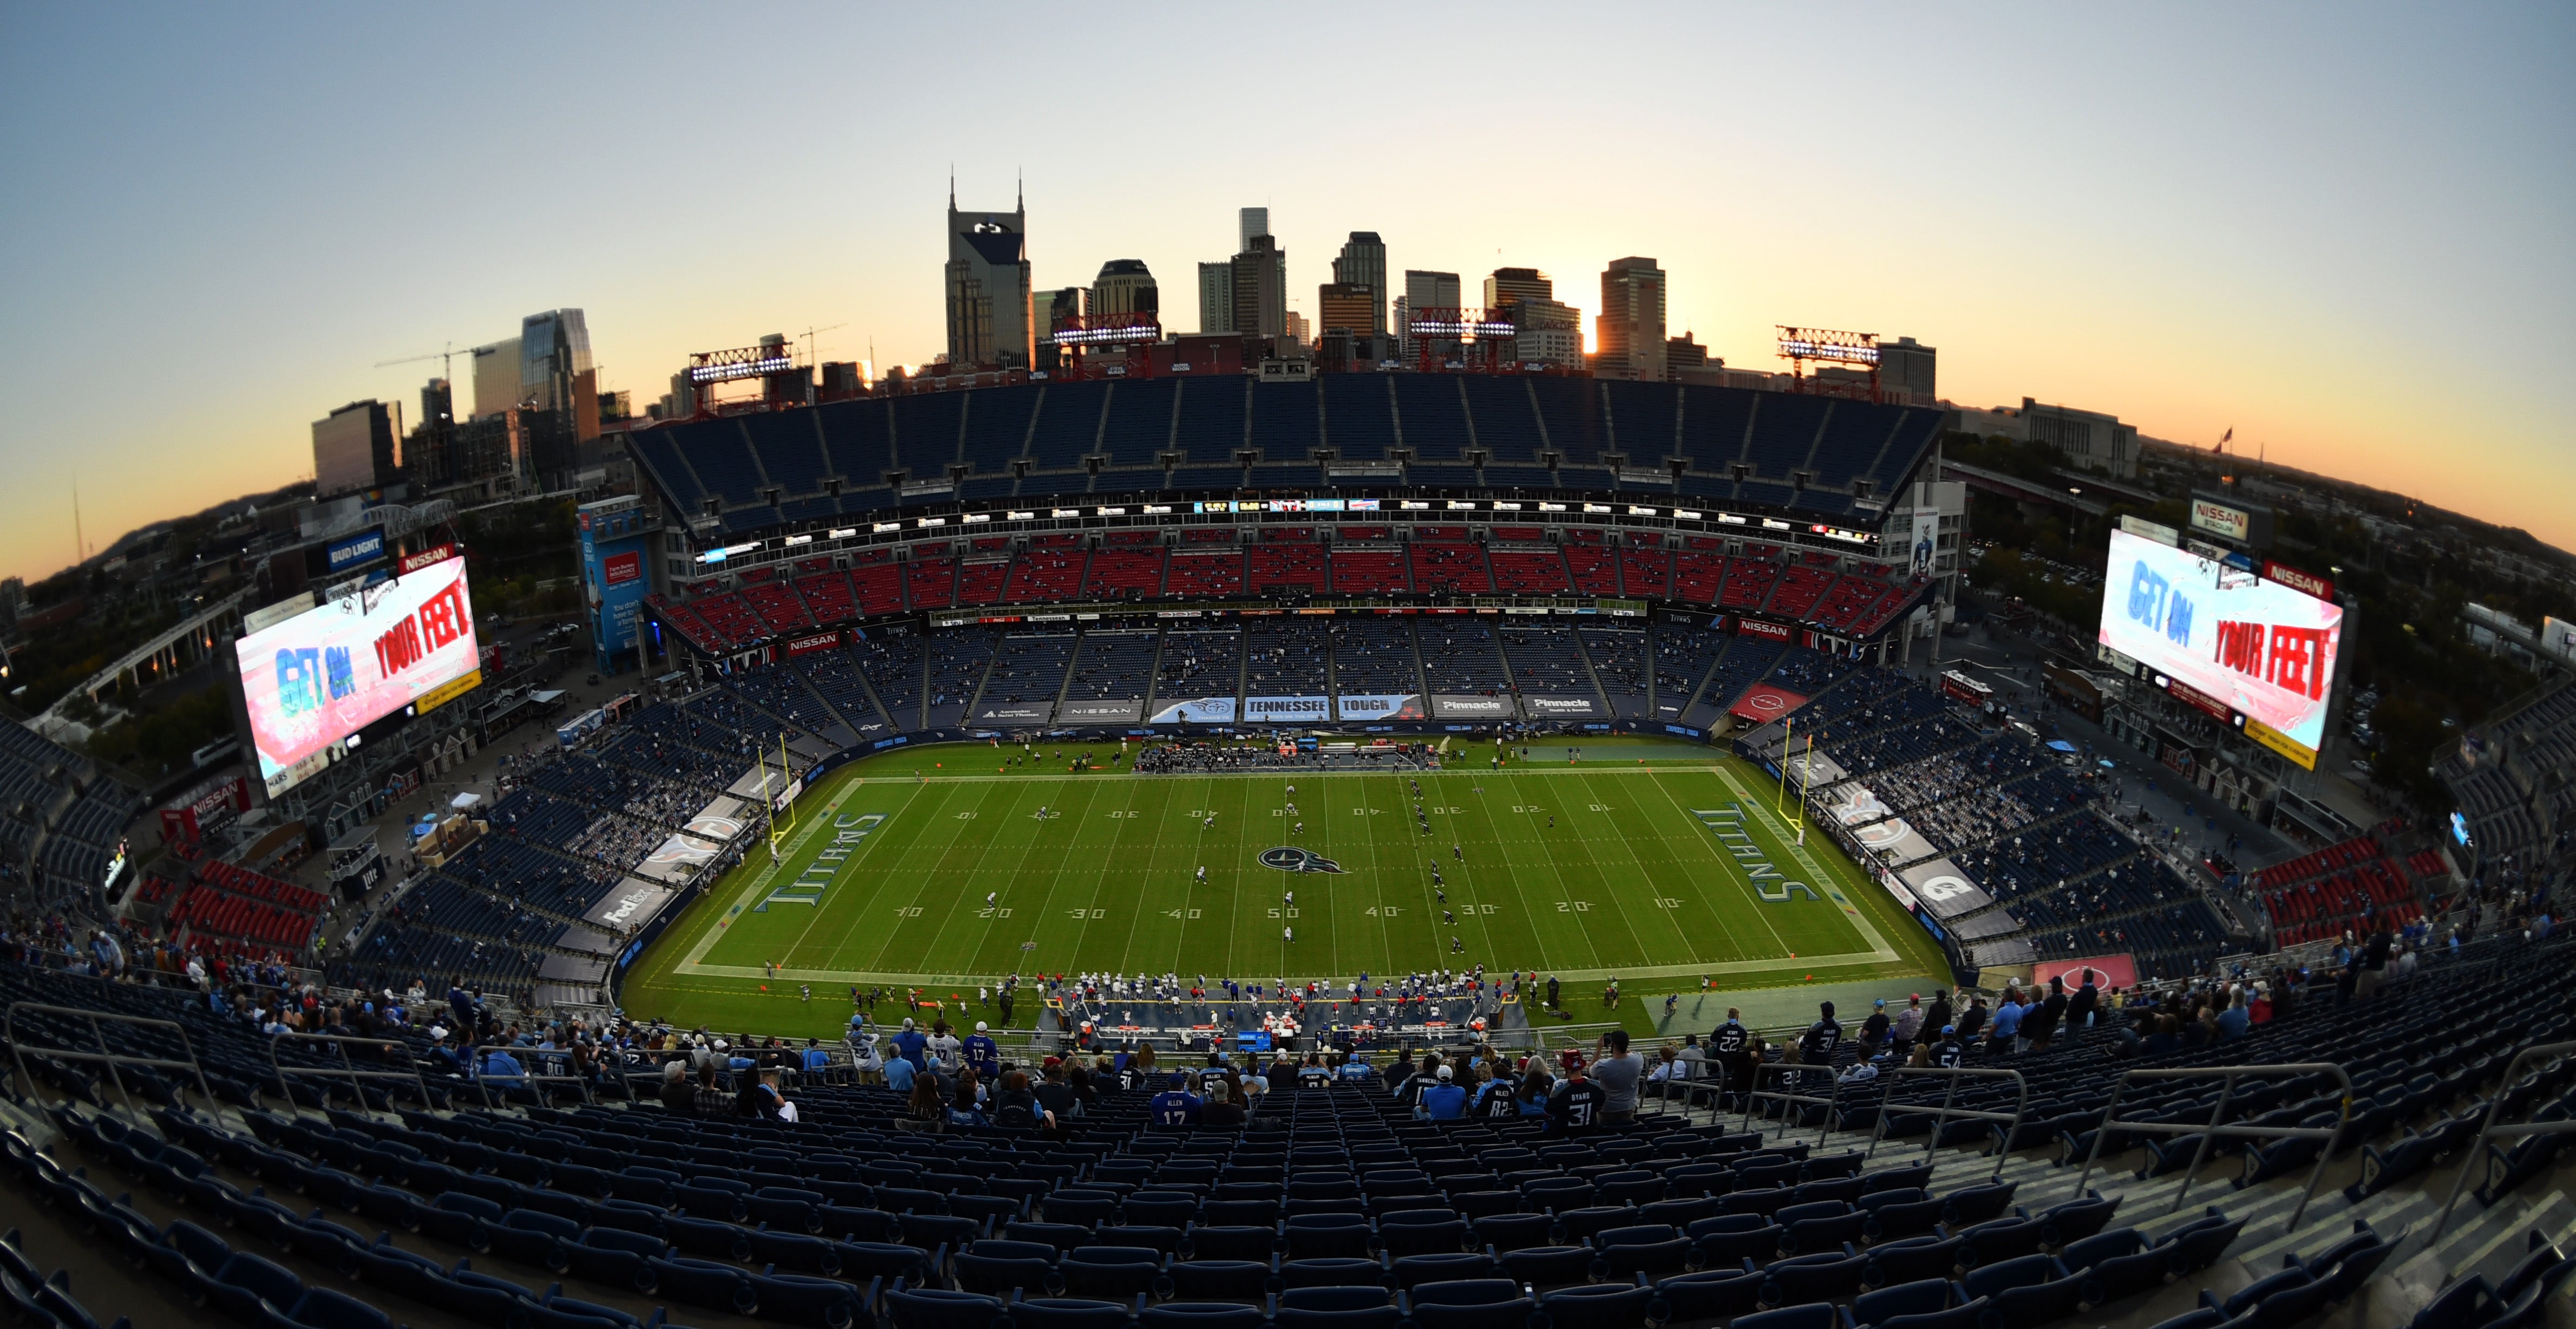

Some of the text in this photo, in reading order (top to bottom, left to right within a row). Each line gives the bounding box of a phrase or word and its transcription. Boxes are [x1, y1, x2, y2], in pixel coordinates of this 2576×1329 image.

[2196, 504, 2243, 527] NISSAN
[2205, 519, 2233, 533] STADIUM
[331, 538, 379, 563] BUD LIGHT
[406, 547, 447, 570] NISSAN
[2271, 565, 2324, 595] NISSAN
[625, 600, 639, 608] don't
[1670, 614, 1690, 623] TITANS
[886, 626, 907, 635] TITANS
[1741, 621, 1787, 636] NISSAN
[2128, 561, 2331, 701] GET ON YOUR FEET
[276, 574, 469, 718] GET ON YOUR FEET
[790, 634, 836, 650] NISSAN
[1534, 699, 1590, 707] Pinnacle
[1750, 696, 1784, 708] NISSAN
[2172, 681, 2183, 689] Farm
[2182, 685, 2199, 698] Bureau
[2199, 692, 2227, 713] INSURANCE
[1249, 700, 1325, 712] TENNESSEE
[1343, 699, 1390, 711] TOUGH
[1443, 701, 1501, 709] Pinnacle
[1738, 712, 1757, 721] NISSAN
[267, 772, 287, 787] MARS
[193, 781, 238, 816] NISSAN
[210, 816, 236, 834] TITAN
[1688, 802, 1821, 902] TITANS
[752, 813, 888, 912] TITANS
[362, 868, 378, 890] Lite
[1815, 874, 1831, 884] US
[603, 889, 653, 923] FedEx
[1462, 904, 1495, 914] 30
[1555, 902, 1589, 912] 20
[1654, 898, 1679, 908] 10
[898, 907, 924, 917] 10
[979, 908, 1013, 918] 20
[1072, 909, 1106, 919] 30
[1169, 909, 1201, 918] 40
[1267, 908, 1300, 918] 50
[1365, 907, 1397, 916] 40
[1719, 1037, 1741, 1052] 22
[1815, 1037, 1834, 1052] 31
[936, 1049, 947, 1061] 17
[973, 1049, 985, 1061] 17
[1941, 1054, 1960, 1069] 54
[1120, 1076, 1131, 1090] 31
[1572, 1092, 1590, 1101] BYARD
[952, 1111, 973, 1120] JOHNSON
[1489, 1101, 1509, 1117] 82
[1568, 1103, 1593, 1126] 31
[1164, 1111, 1186, 1125] 17
